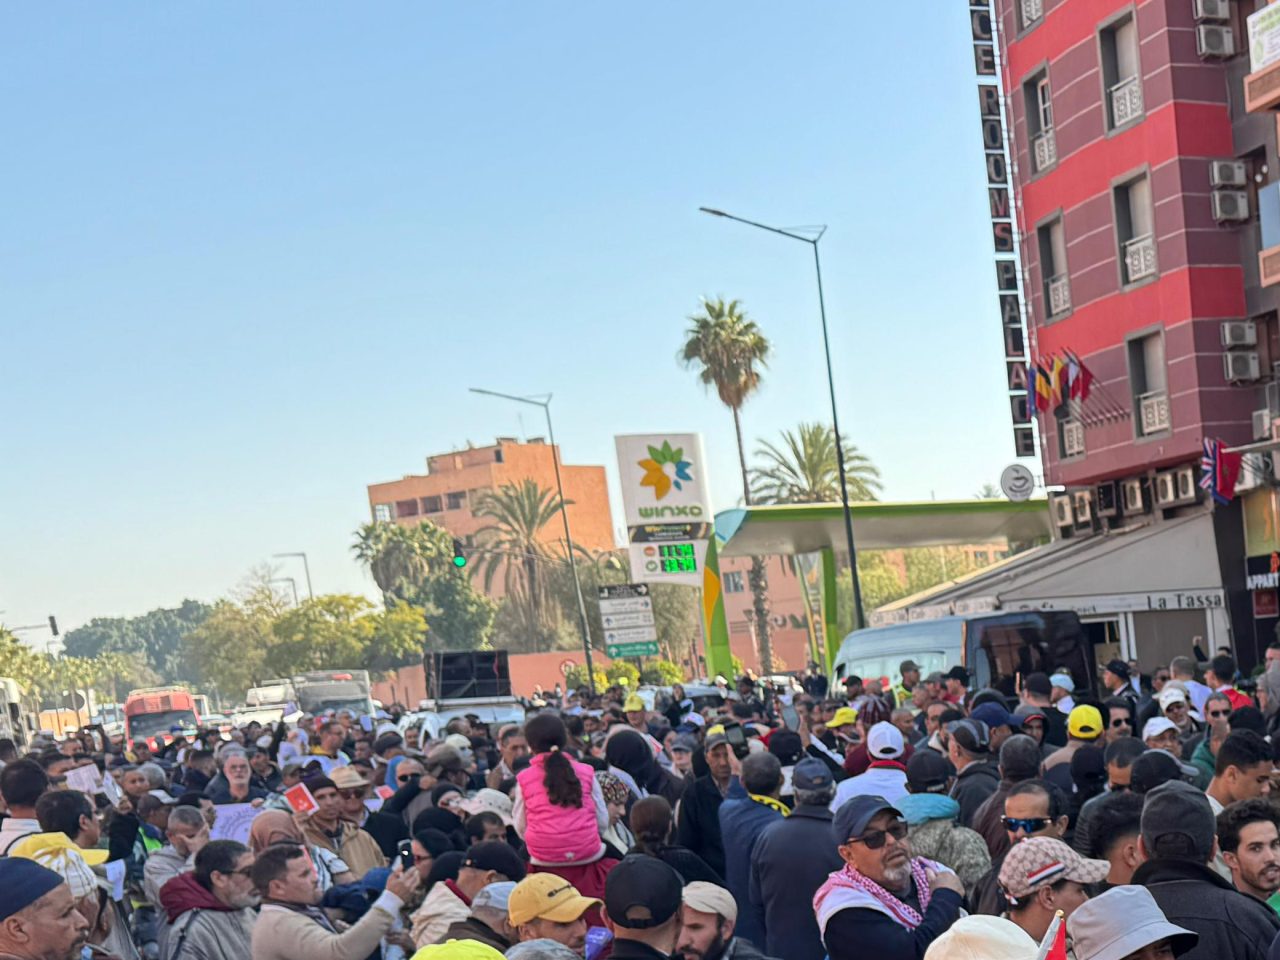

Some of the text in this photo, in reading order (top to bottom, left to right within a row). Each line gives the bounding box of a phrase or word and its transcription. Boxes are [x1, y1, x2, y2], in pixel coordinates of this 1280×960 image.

[968, 0, 997, 76] CE
[980, 87, 1012, 251] ROOMS
[998, 261, 1035, 456] PALACE
[1146, 593, 1222, 610] La Tassa
[1246, 572, 1279, 591] APPART
